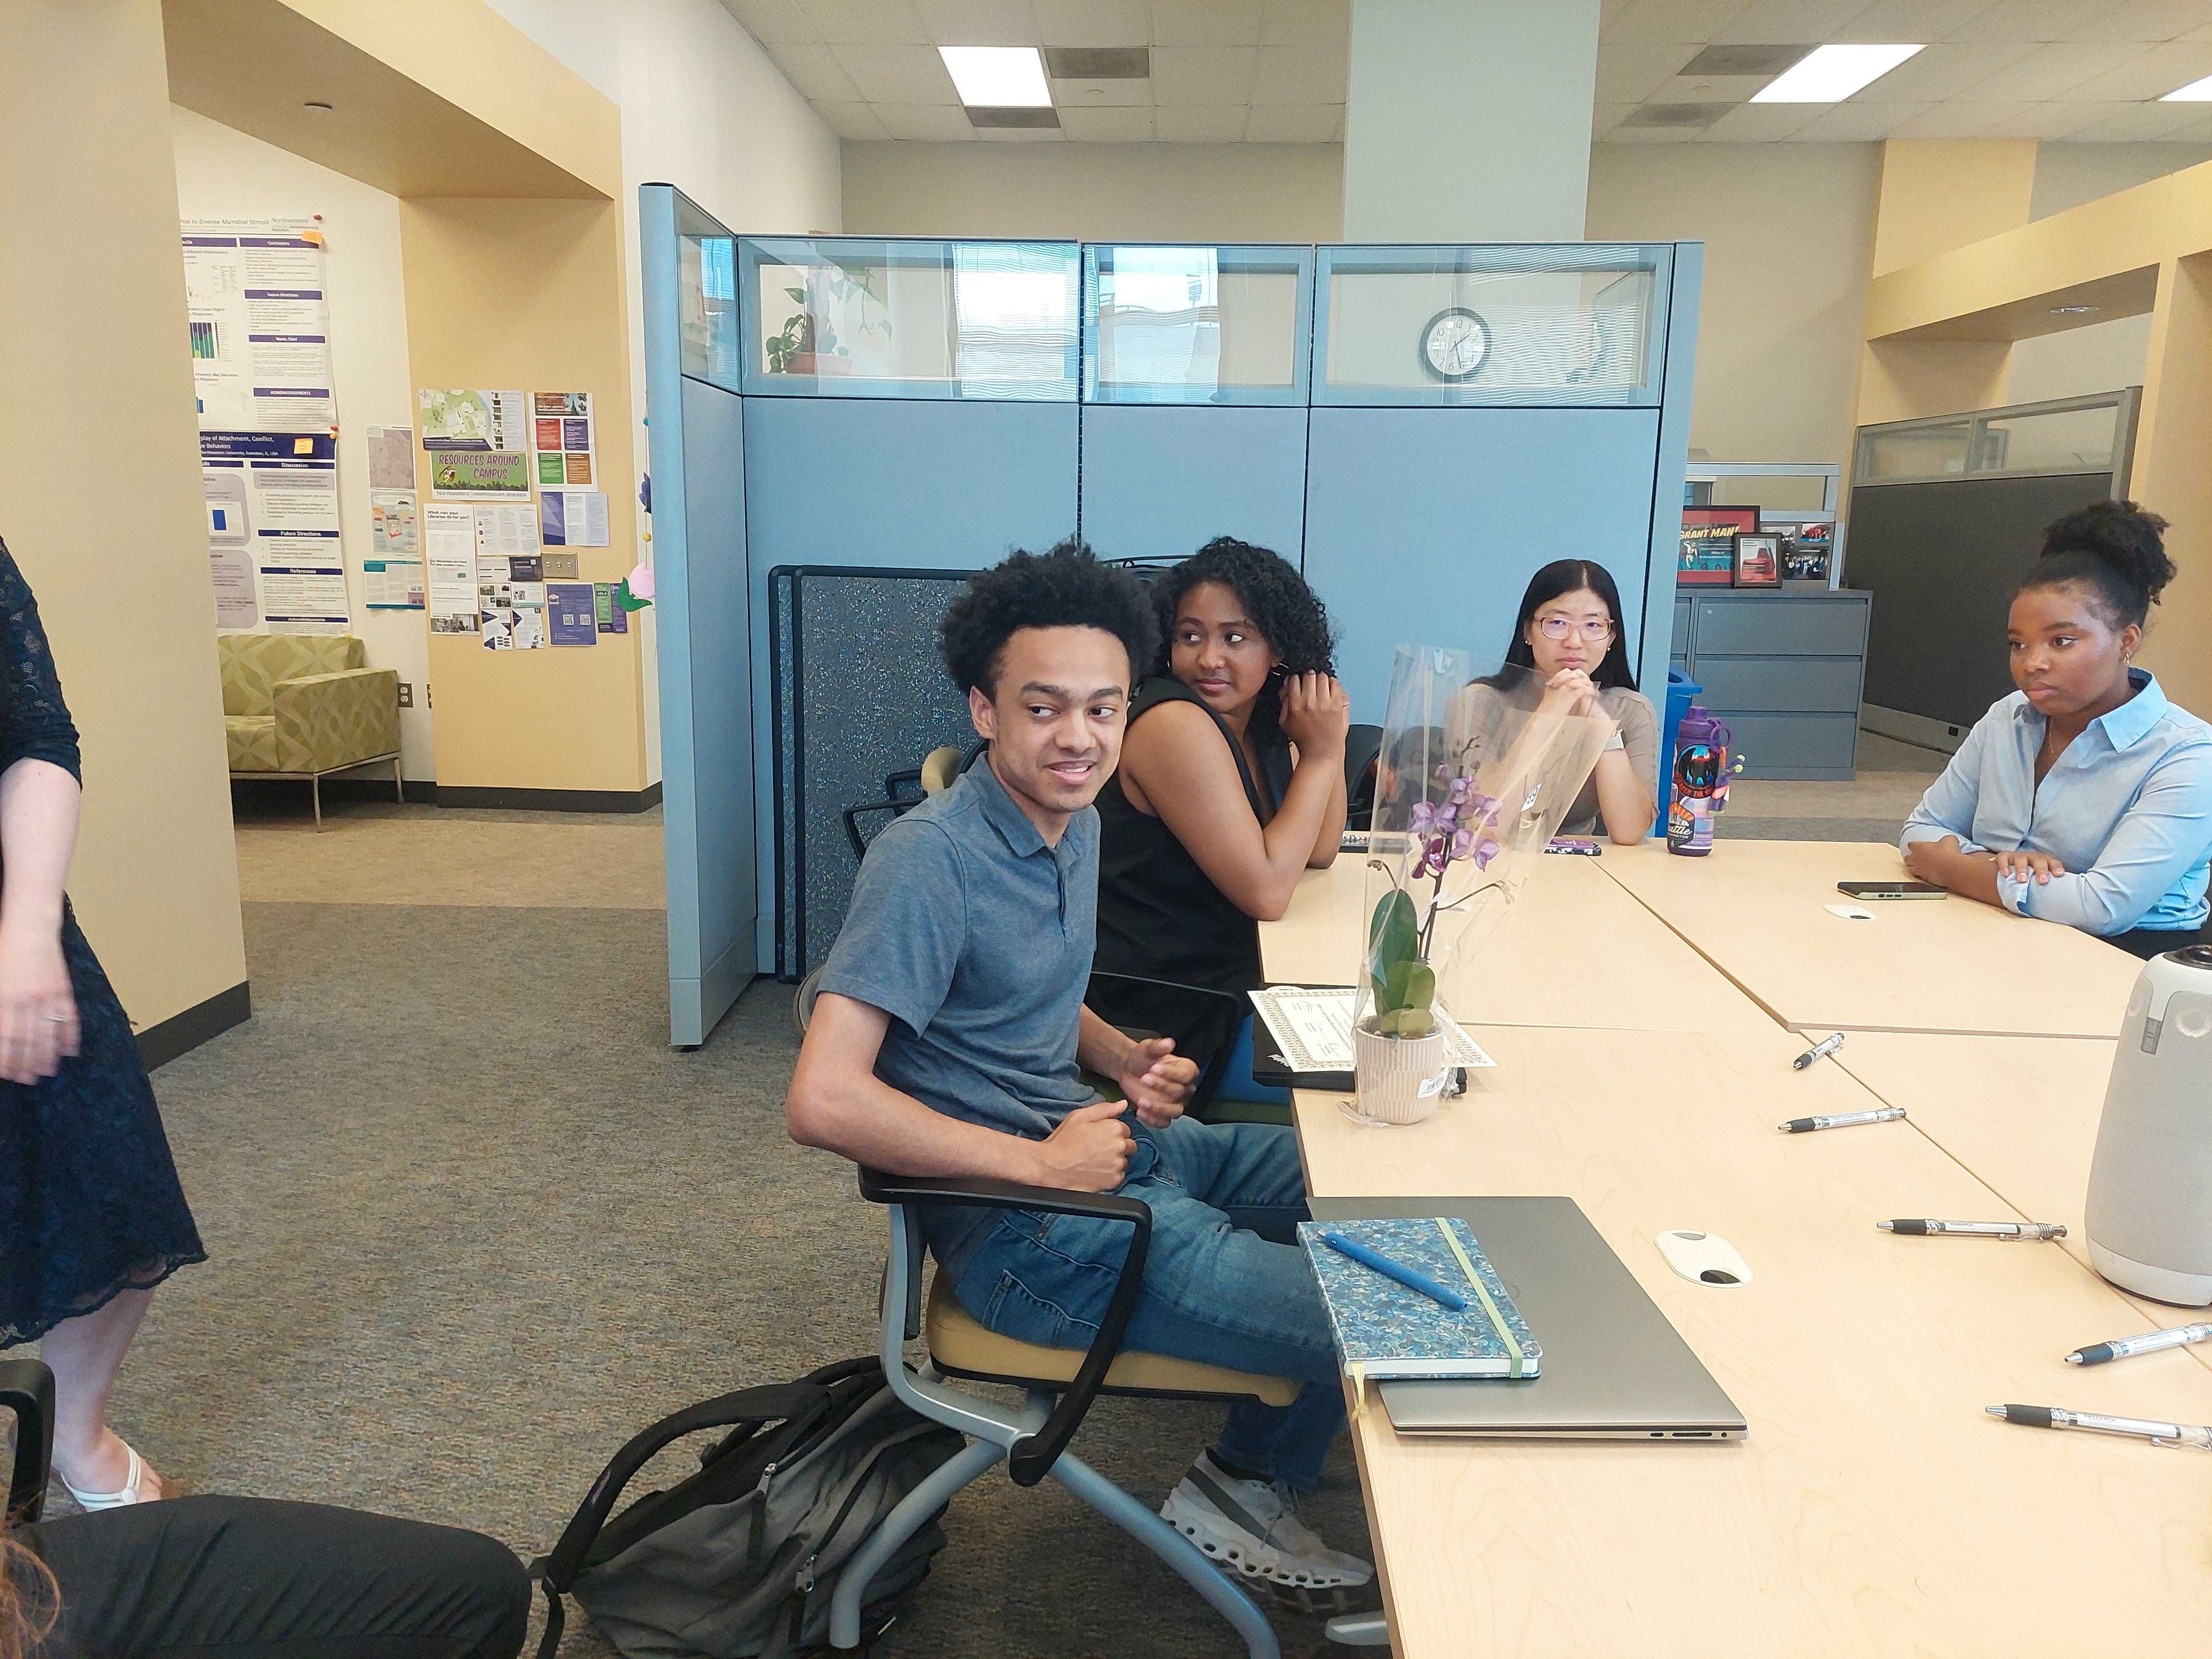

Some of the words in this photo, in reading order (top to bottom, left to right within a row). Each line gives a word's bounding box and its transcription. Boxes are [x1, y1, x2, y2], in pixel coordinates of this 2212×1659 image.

[1456, 320, 1463, 329] 12
[1437, 328, 1445, 336] 10
[1449, 362, 1454, 371] 6
[439, 454, 484, 466] RESOURCES
[487, 454, 520, 466] AROUND
[473, 468, 508, 479] CAMPUS
